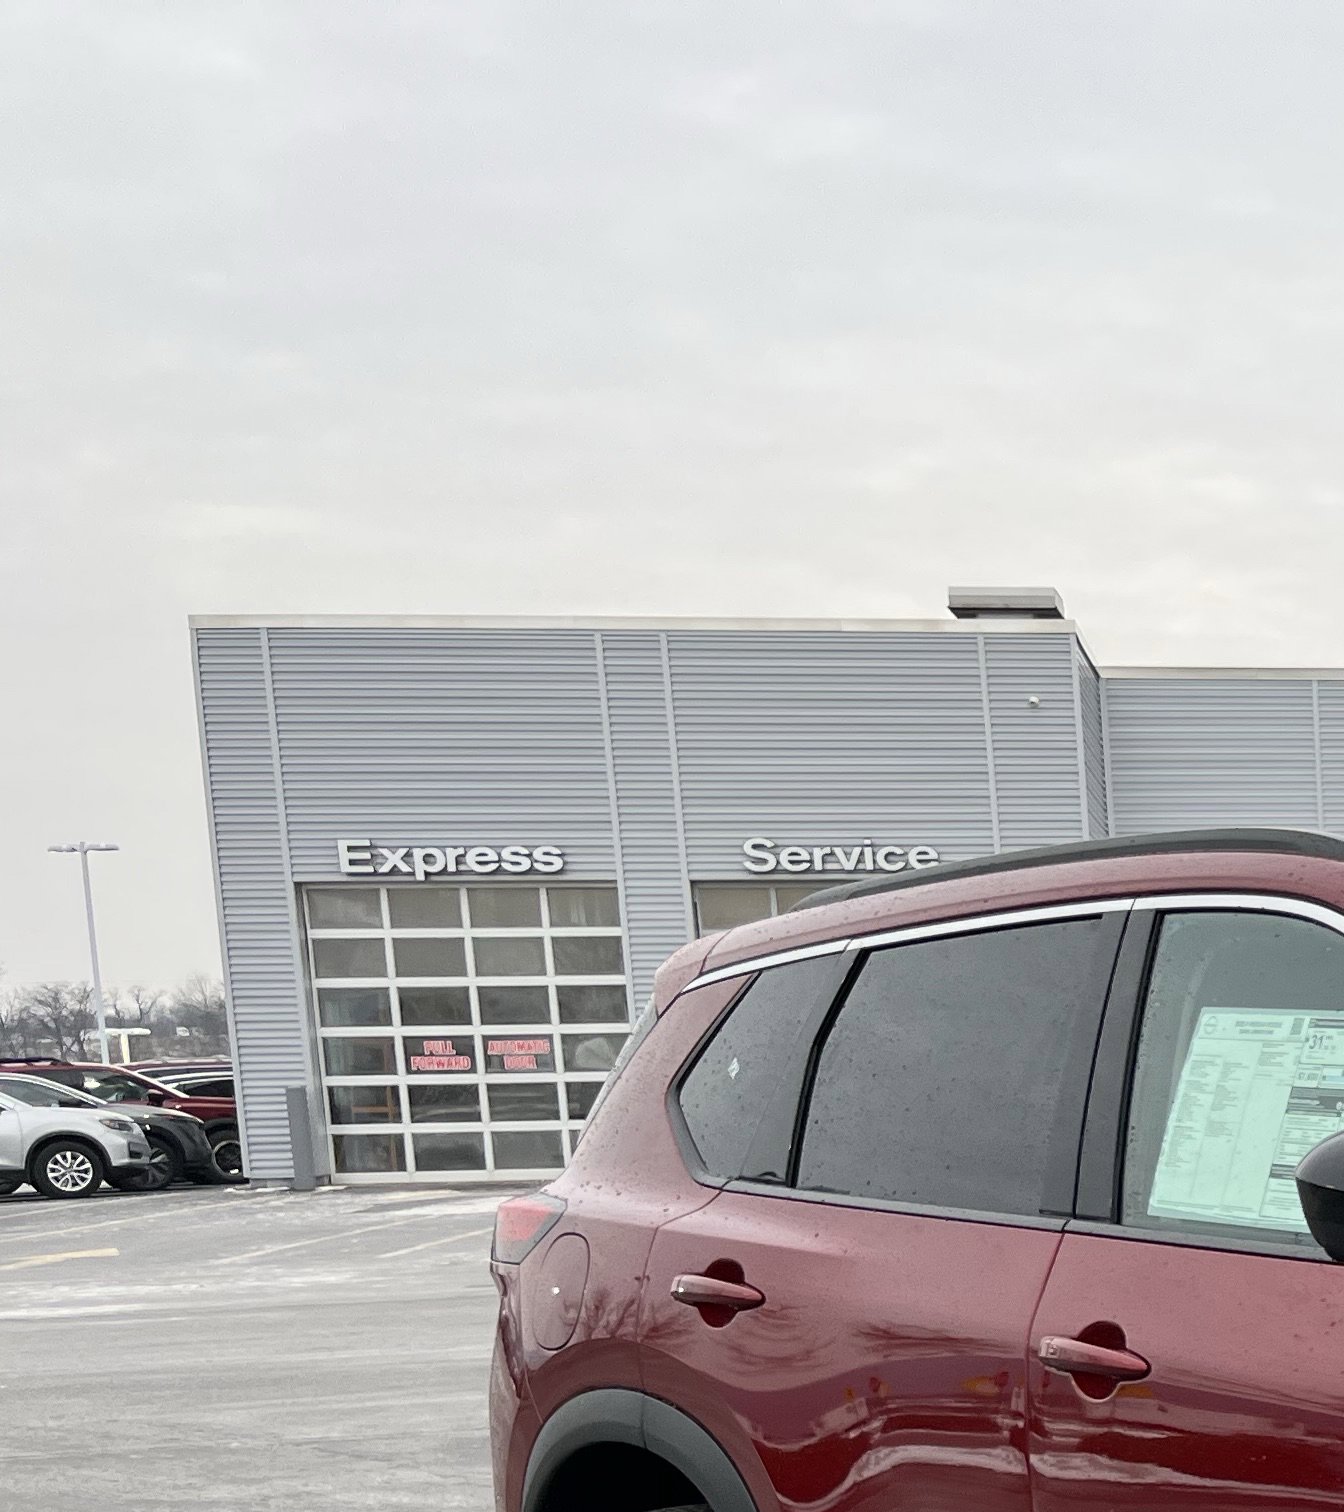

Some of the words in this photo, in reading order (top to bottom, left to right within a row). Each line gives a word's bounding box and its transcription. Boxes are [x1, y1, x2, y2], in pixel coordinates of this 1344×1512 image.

[337, 839, 564, 881] Express
[743, 838, 939, 873] Service
[423, 1040, 456, 1055] PULL
[487, 1040, 550, 1055] AUTOMATIC
[410, 1055, 471, 1071] FORWARD
